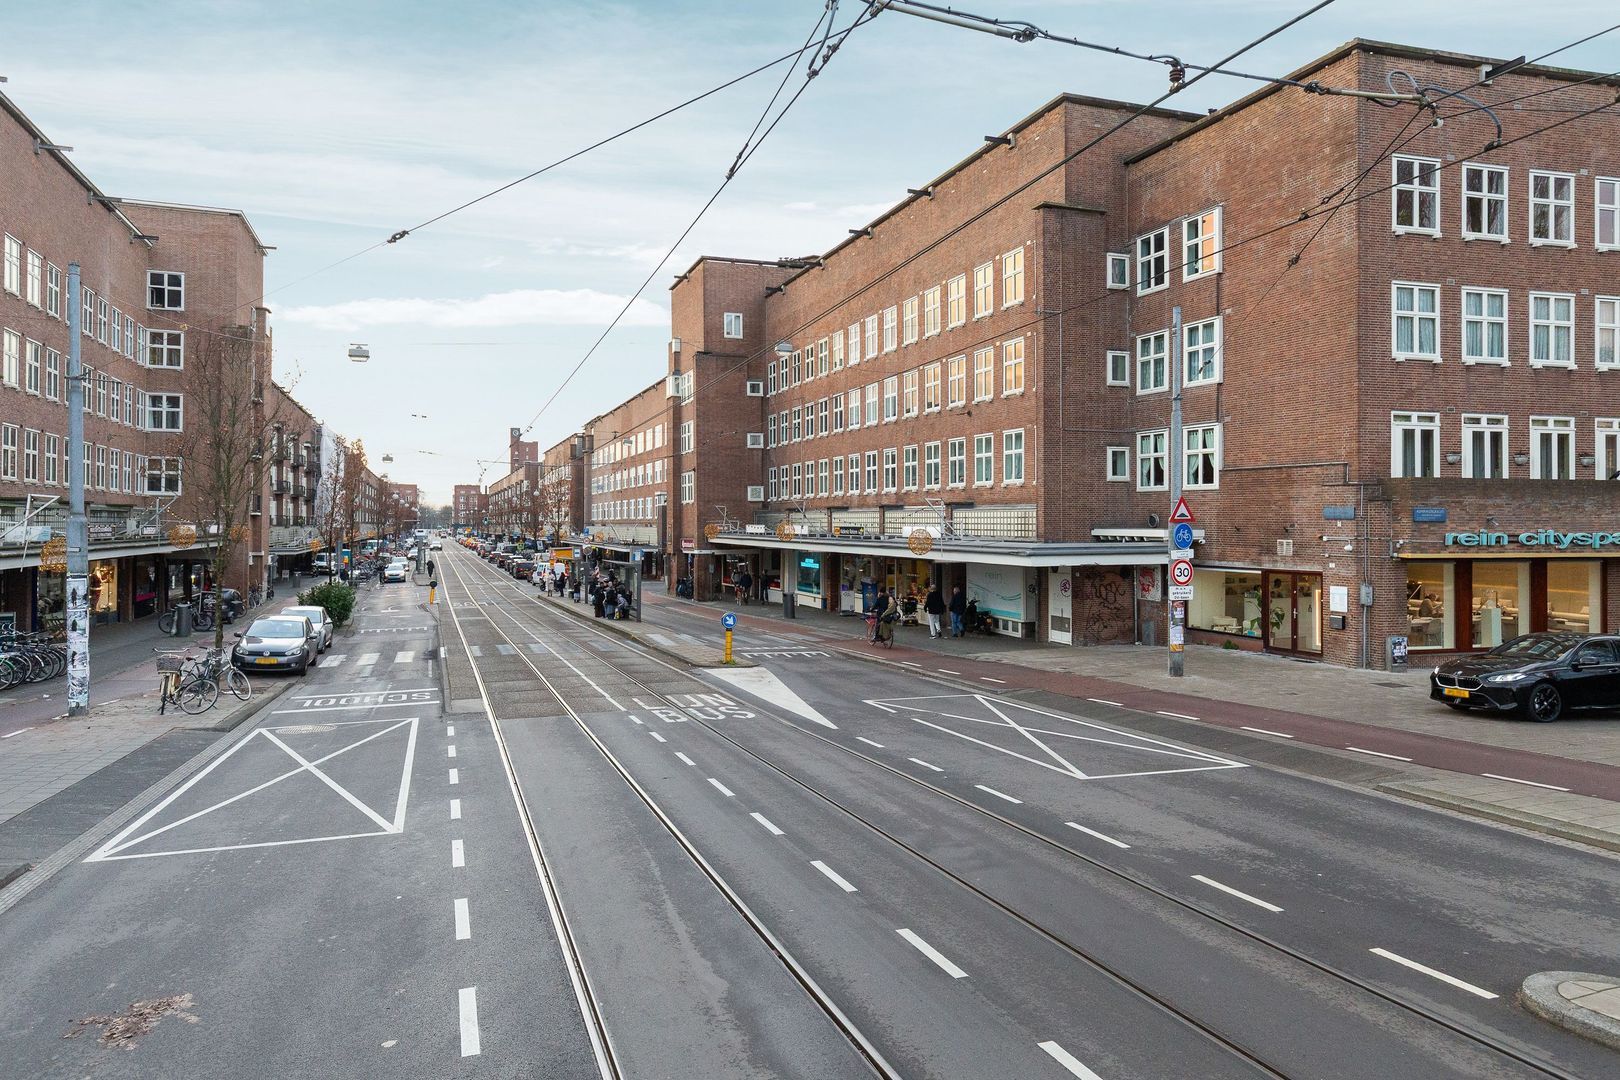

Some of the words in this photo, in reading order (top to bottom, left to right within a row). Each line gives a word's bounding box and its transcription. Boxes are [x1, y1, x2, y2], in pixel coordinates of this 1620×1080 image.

[1444, 529, 1508, 546] rein
[1176, 567, 1189, 577] 30
[302, 692, 431, 707] SCHOOL
[632, 693, 736, 710] LIJN
[651, 706, 756, 723] BUS
